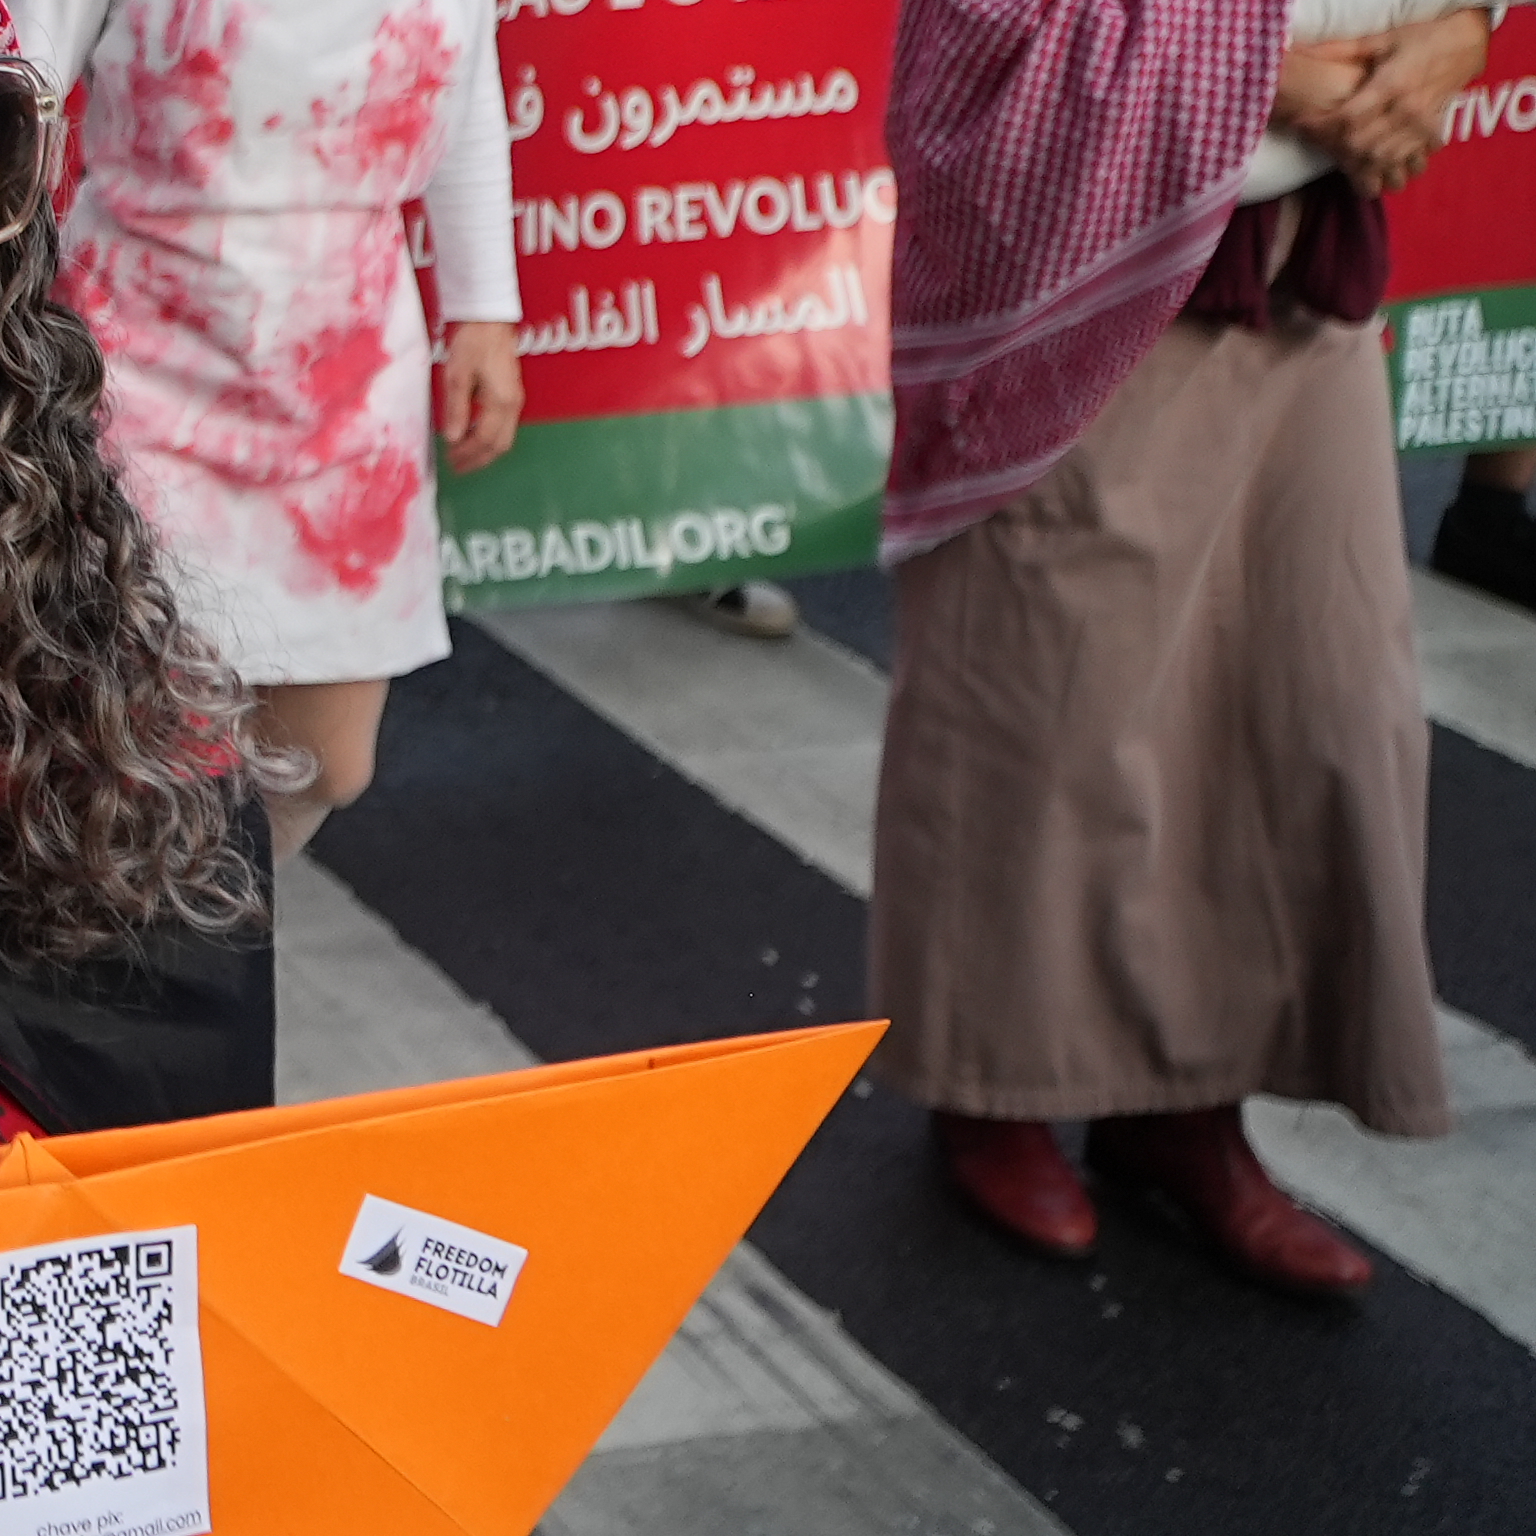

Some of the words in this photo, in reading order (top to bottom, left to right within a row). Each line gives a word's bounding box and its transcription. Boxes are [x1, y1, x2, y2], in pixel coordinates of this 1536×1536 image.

[564, 65, 860, 155] مستمرون
[414, 1255, 498, 1300] FLOTILLA
[421, 1236, 509, 1279] FREEDOM
[36, 1516, 92, 1536] chave
